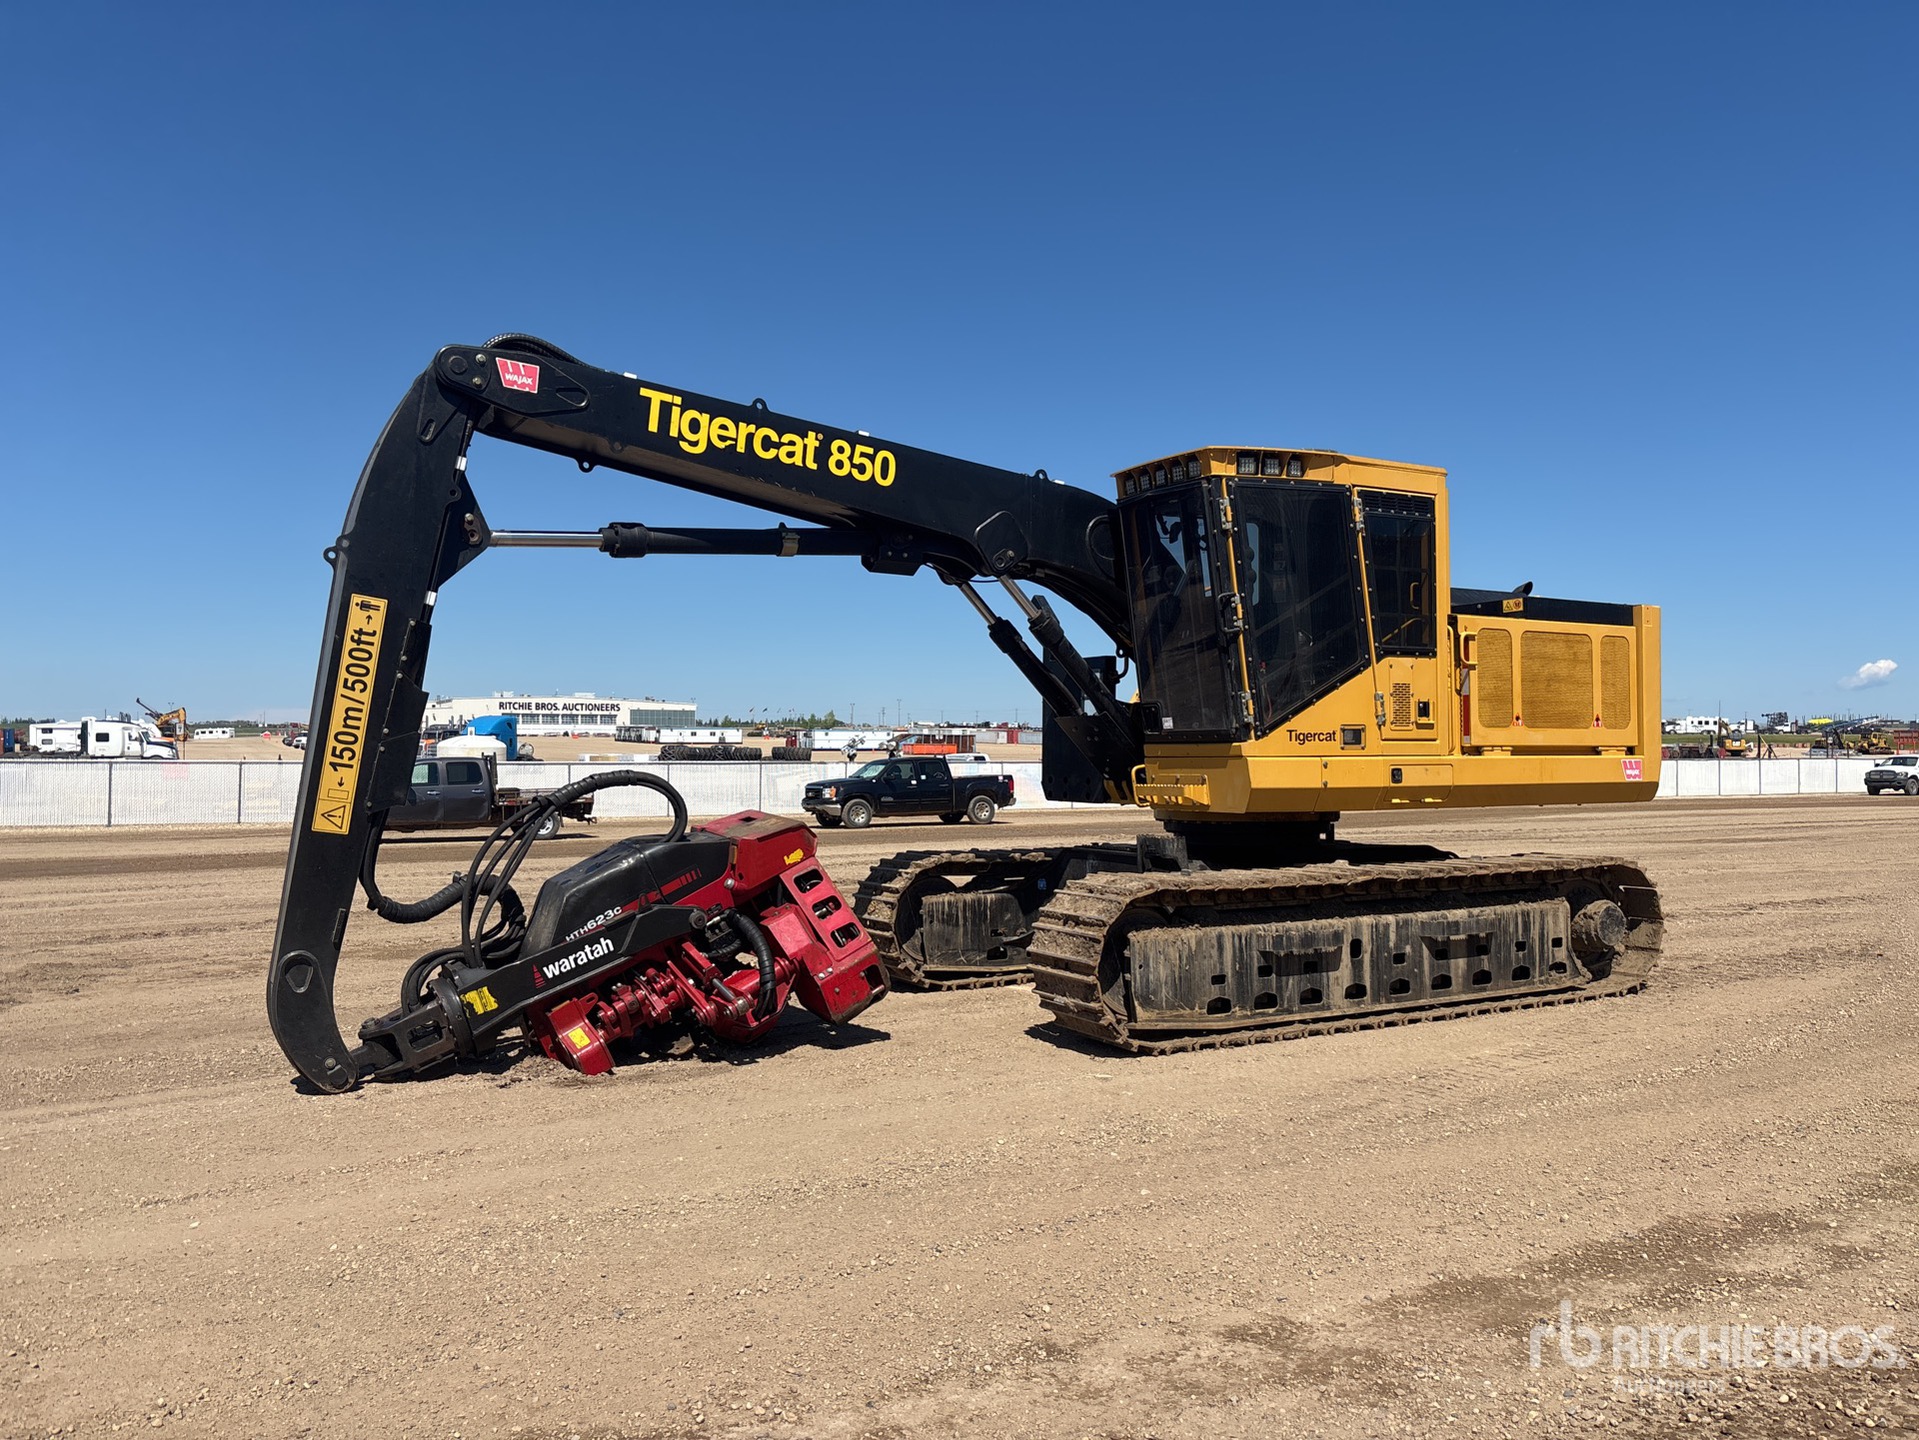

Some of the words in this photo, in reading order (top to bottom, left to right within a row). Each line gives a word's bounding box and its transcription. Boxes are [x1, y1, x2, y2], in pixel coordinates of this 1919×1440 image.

[505, 373, 533, 385] WAJAX
[639, 387, 819, 470] Tigercat
[828, 439, 897, 487] 850
[499, 702, 532, 710] RITCHIE
[535, 703, 560, 711] BROS.
[562, 703, 621, 711] AUCTIONEERS
[1286, 729, 1337, 745] Tigercat
[542, 937, 615, 979] waratah
